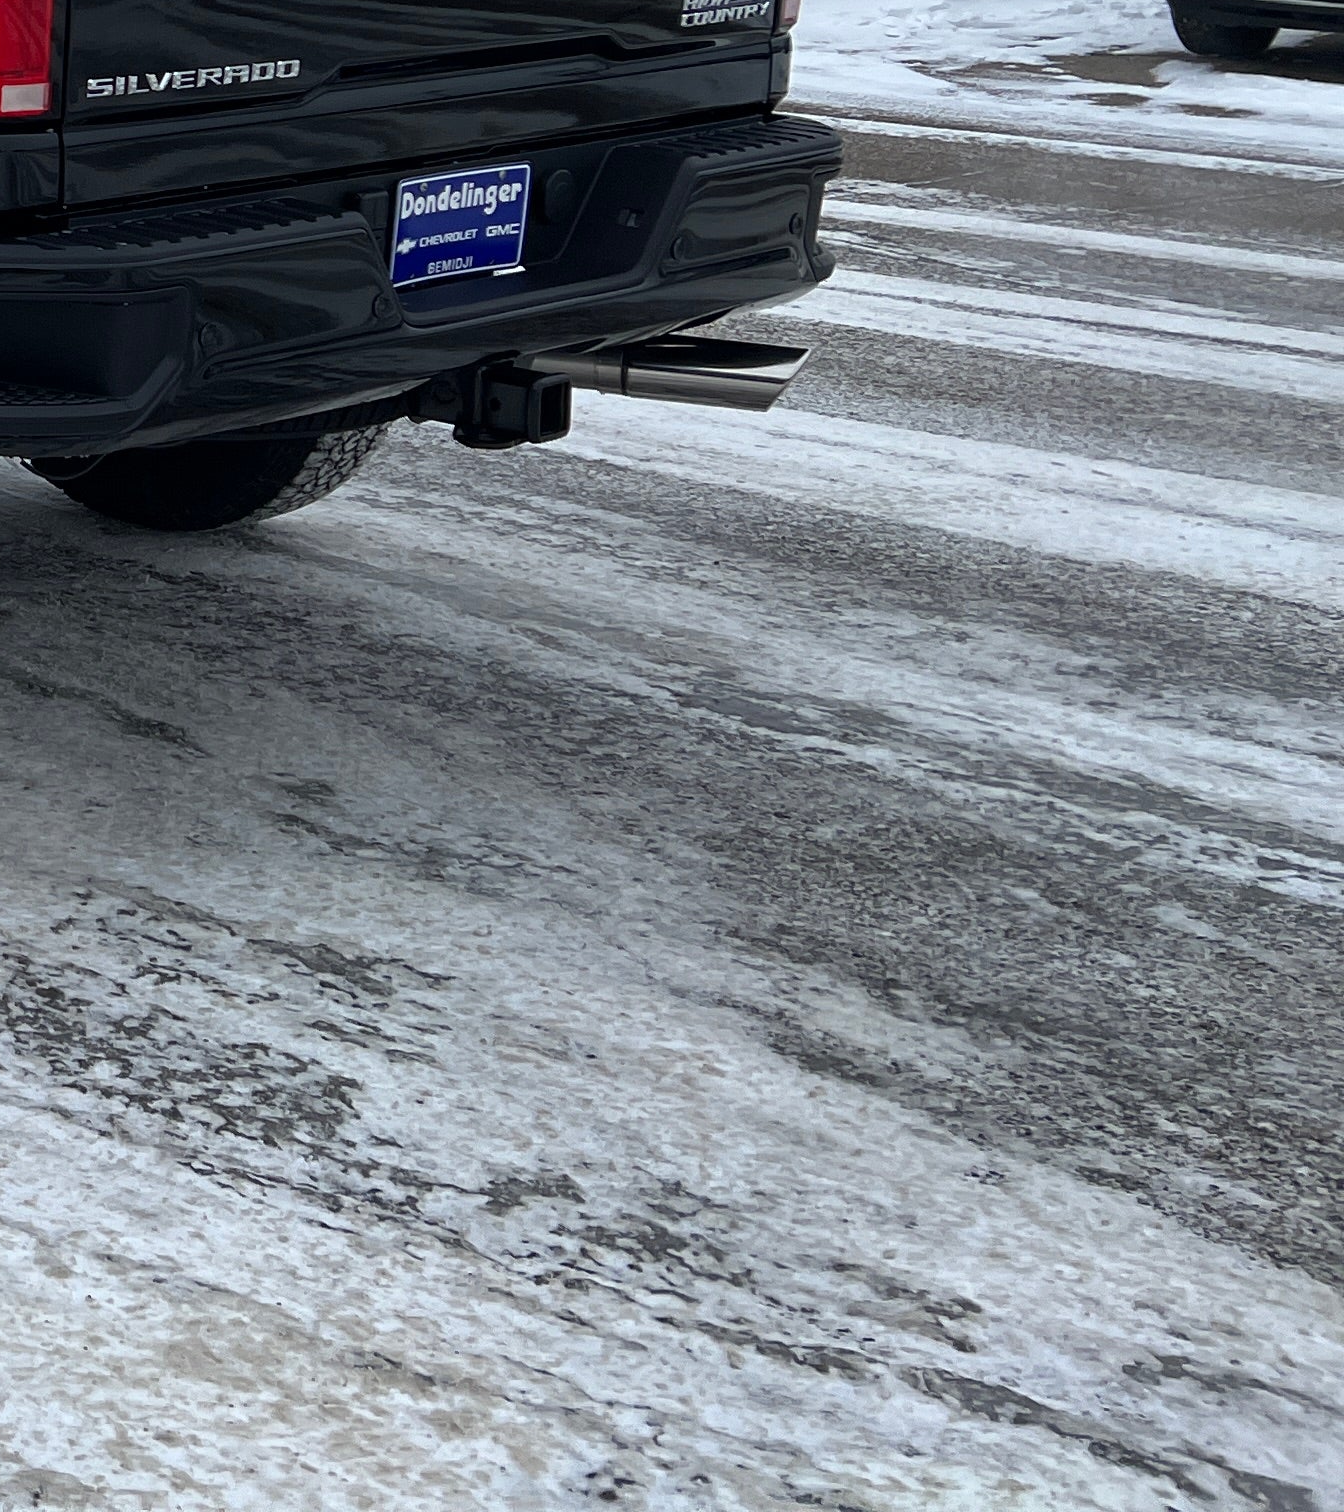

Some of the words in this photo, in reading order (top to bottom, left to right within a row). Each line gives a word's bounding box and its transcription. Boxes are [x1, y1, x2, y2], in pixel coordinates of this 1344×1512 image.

[680, 1, 770, 27] COUNTRY
[86, 59, 301, 98] SILVERADO
[400, 181, 523, 220] Dondelinger
[419, 228, 479, 247] CHEVROLET
[485, 223, 521, 237] GMC
